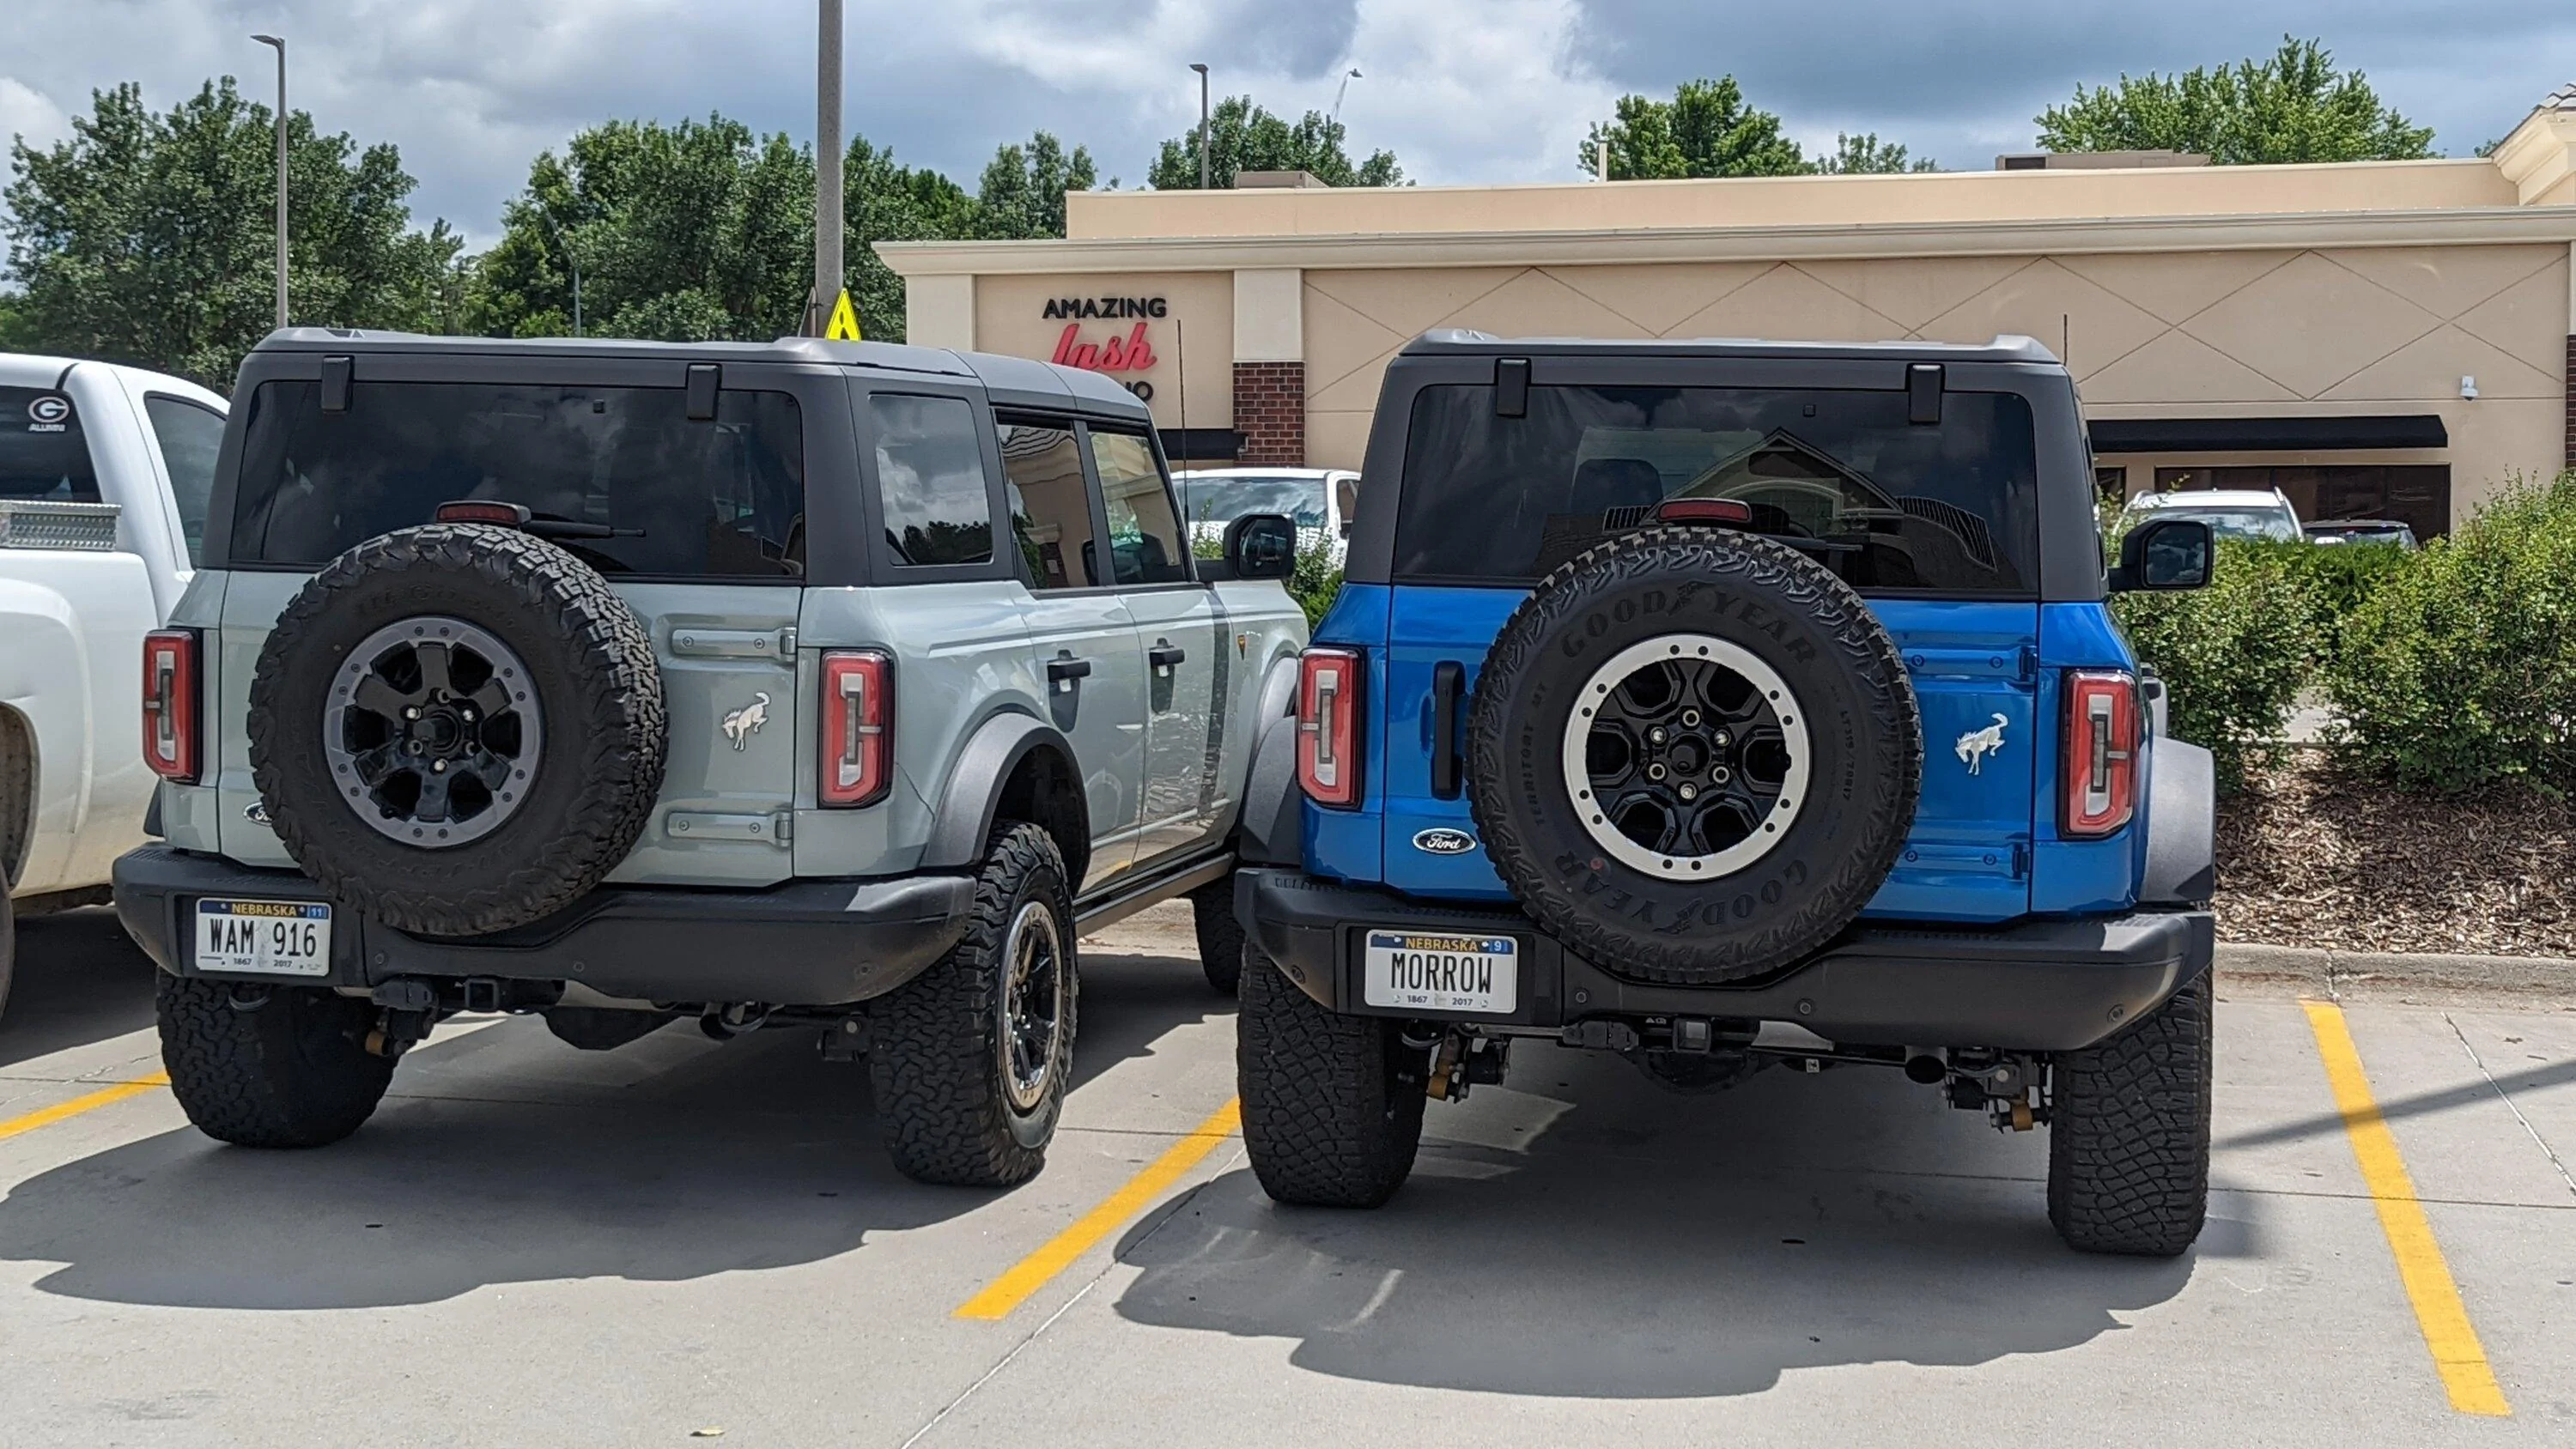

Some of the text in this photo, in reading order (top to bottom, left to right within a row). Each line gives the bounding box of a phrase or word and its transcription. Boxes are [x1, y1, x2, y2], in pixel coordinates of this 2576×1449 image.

[1042, 297, 1167, 318] AMAZING
[1052, 322, 1157, 371] lash
[1426, 833, 1461, 849] Ford
[232, 903, 322, 917] NEBRASKA 11
[210, 918, 316, 958] WAM 916
[1405, 937, 1502, 952] NEBRASKA 9
[273, 960, 293, 968] 2017
[1391, 952, 1492, 994] MORROW
[1406, 995, 1473, 1006] 1867 2017
